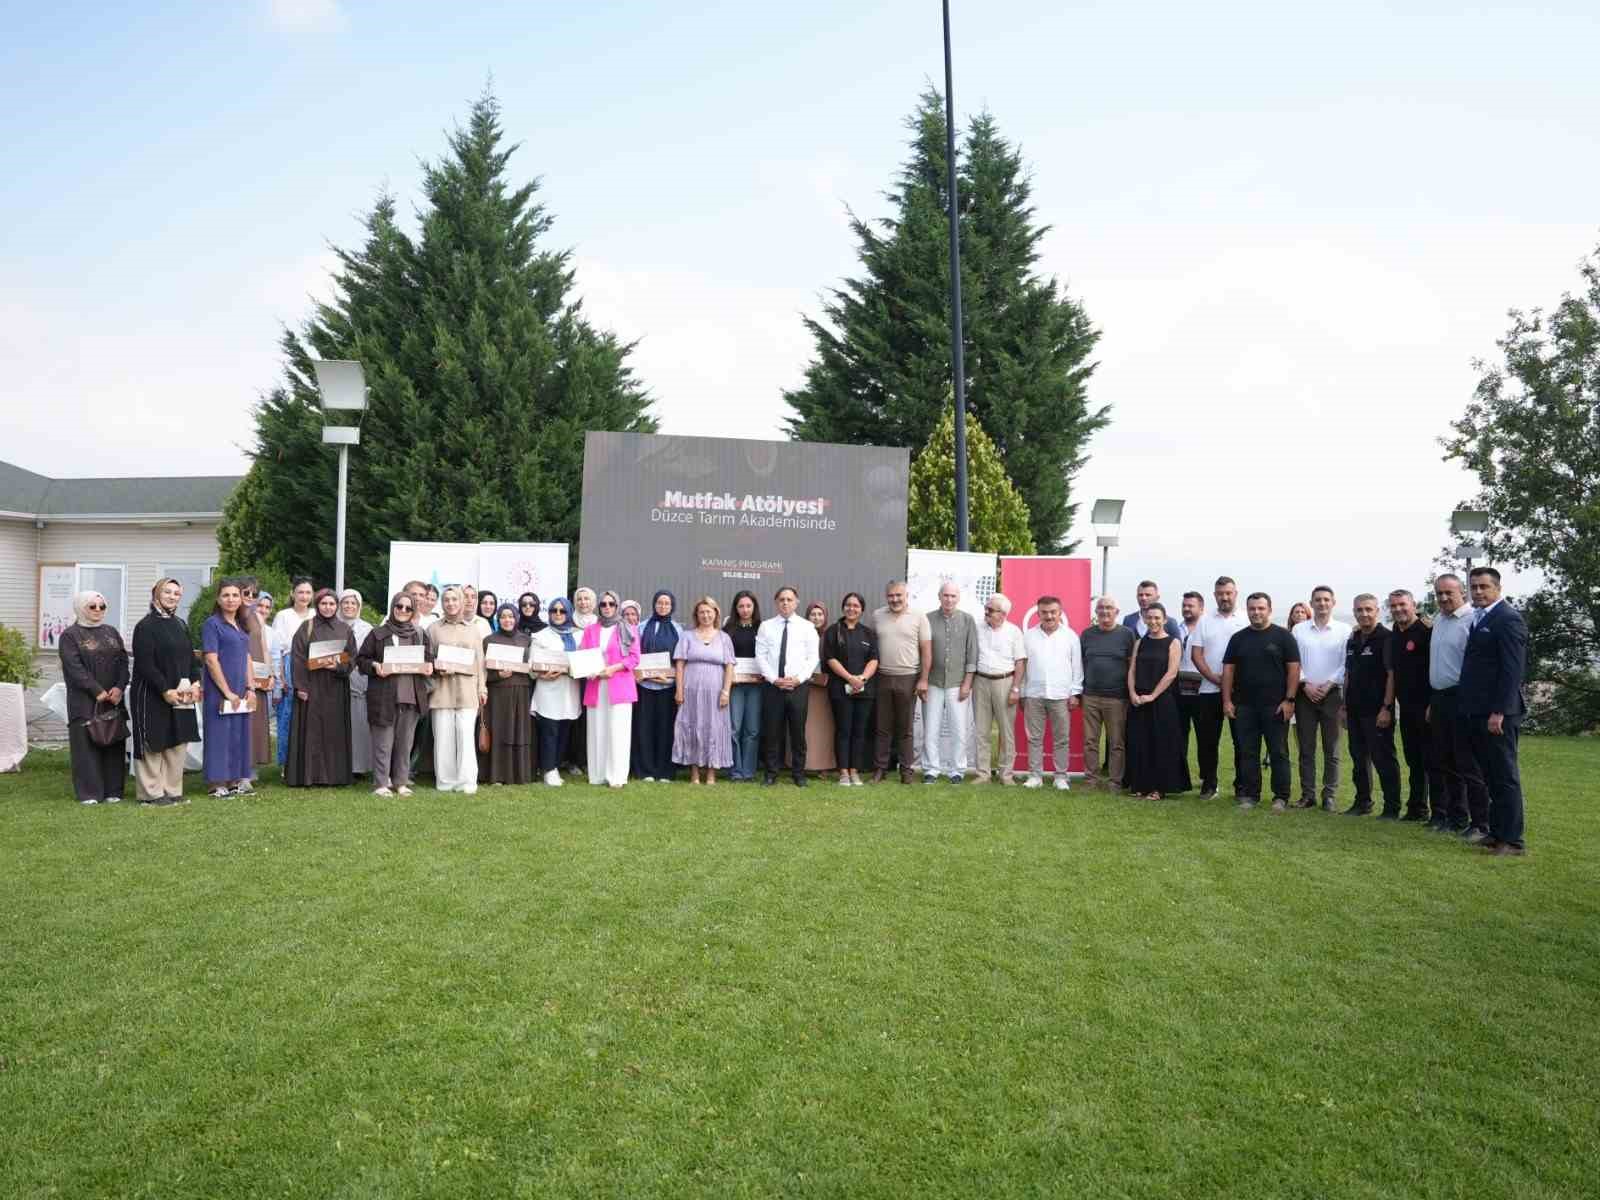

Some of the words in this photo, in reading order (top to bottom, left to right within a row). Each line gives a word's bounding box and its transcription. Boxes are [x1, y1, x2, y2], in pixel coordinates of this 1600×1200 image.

[664, 490, 736, 510] Mutfak
[741, 494, 824, 515] Atölyesi
[651, 508, 694, 524] Düzce
[740, 514, 836, 530] Akademisinde
